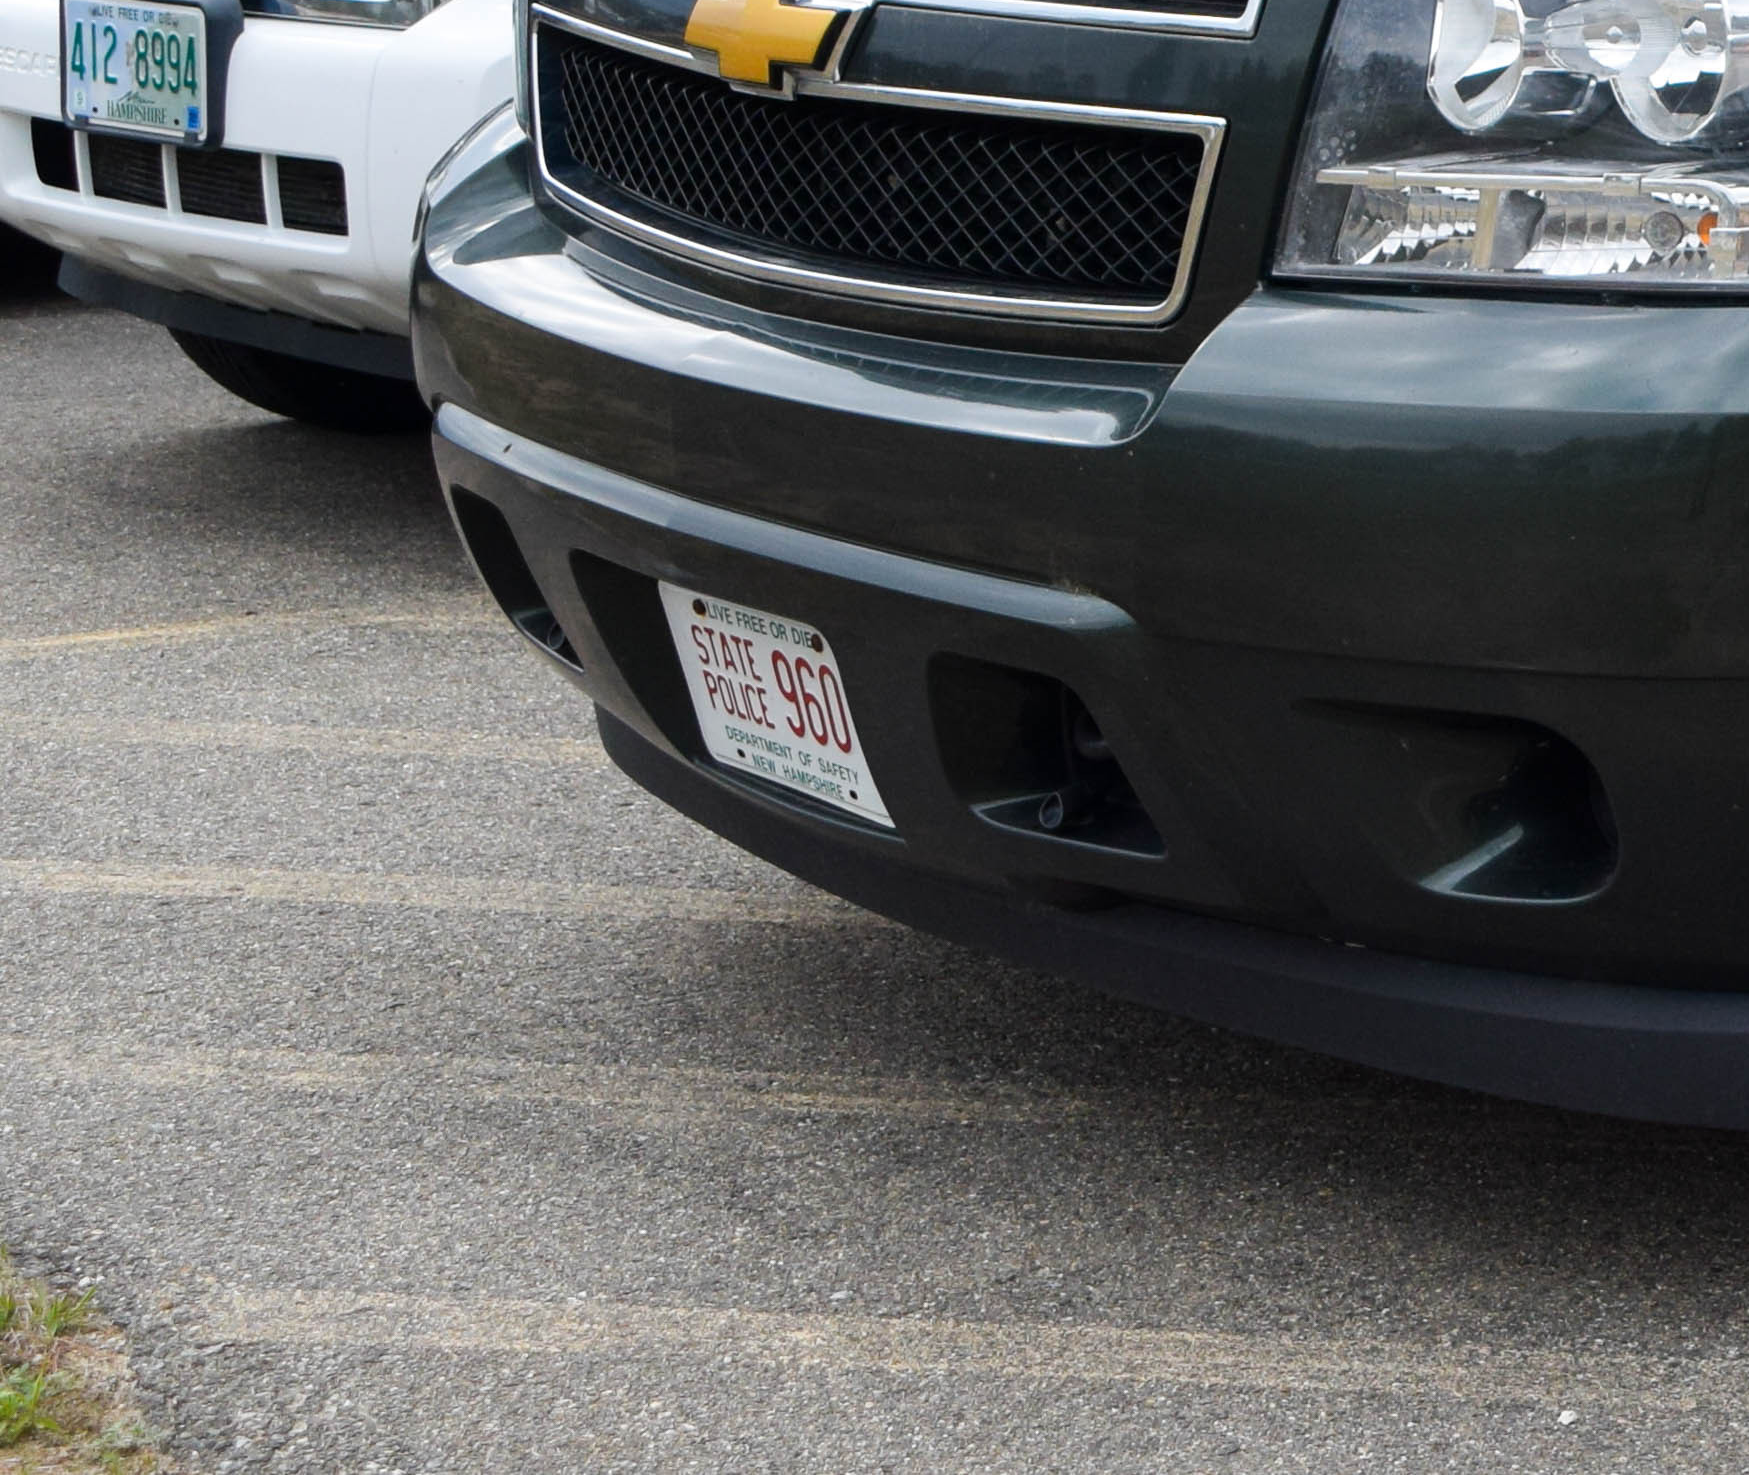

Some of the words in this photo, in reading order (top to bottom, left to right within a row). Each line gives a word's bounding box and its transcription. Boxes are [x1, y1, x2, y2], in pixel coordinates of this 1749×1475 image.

[118, 7, 138, 21] FREE
[143, 10, 155, 22] OR
[71, 21, 118, 84] 412
[135, 28, 198, 96] 8994
[107, 99, 168, 125] HAMPSHIRE
[691, 624, 763, 682] STATE
[706, 602, 734, 625] LIVE
[736, 611, 767, 636] FREE
[770, 621, 787, 641] OR
[792, 627, 813, 649] DIE
[703, 670, 776, 730] POLICE
[771, 649, 853, 754] 960
[725, 725, 794, 759] DEPARTMENT
[799, 750, 813, 768] OF
[818, 757, 859, 785] SAFETY
[752, 753, 777, 774] NEW
[783, 764, 845, 799] HAMPSHIRE
